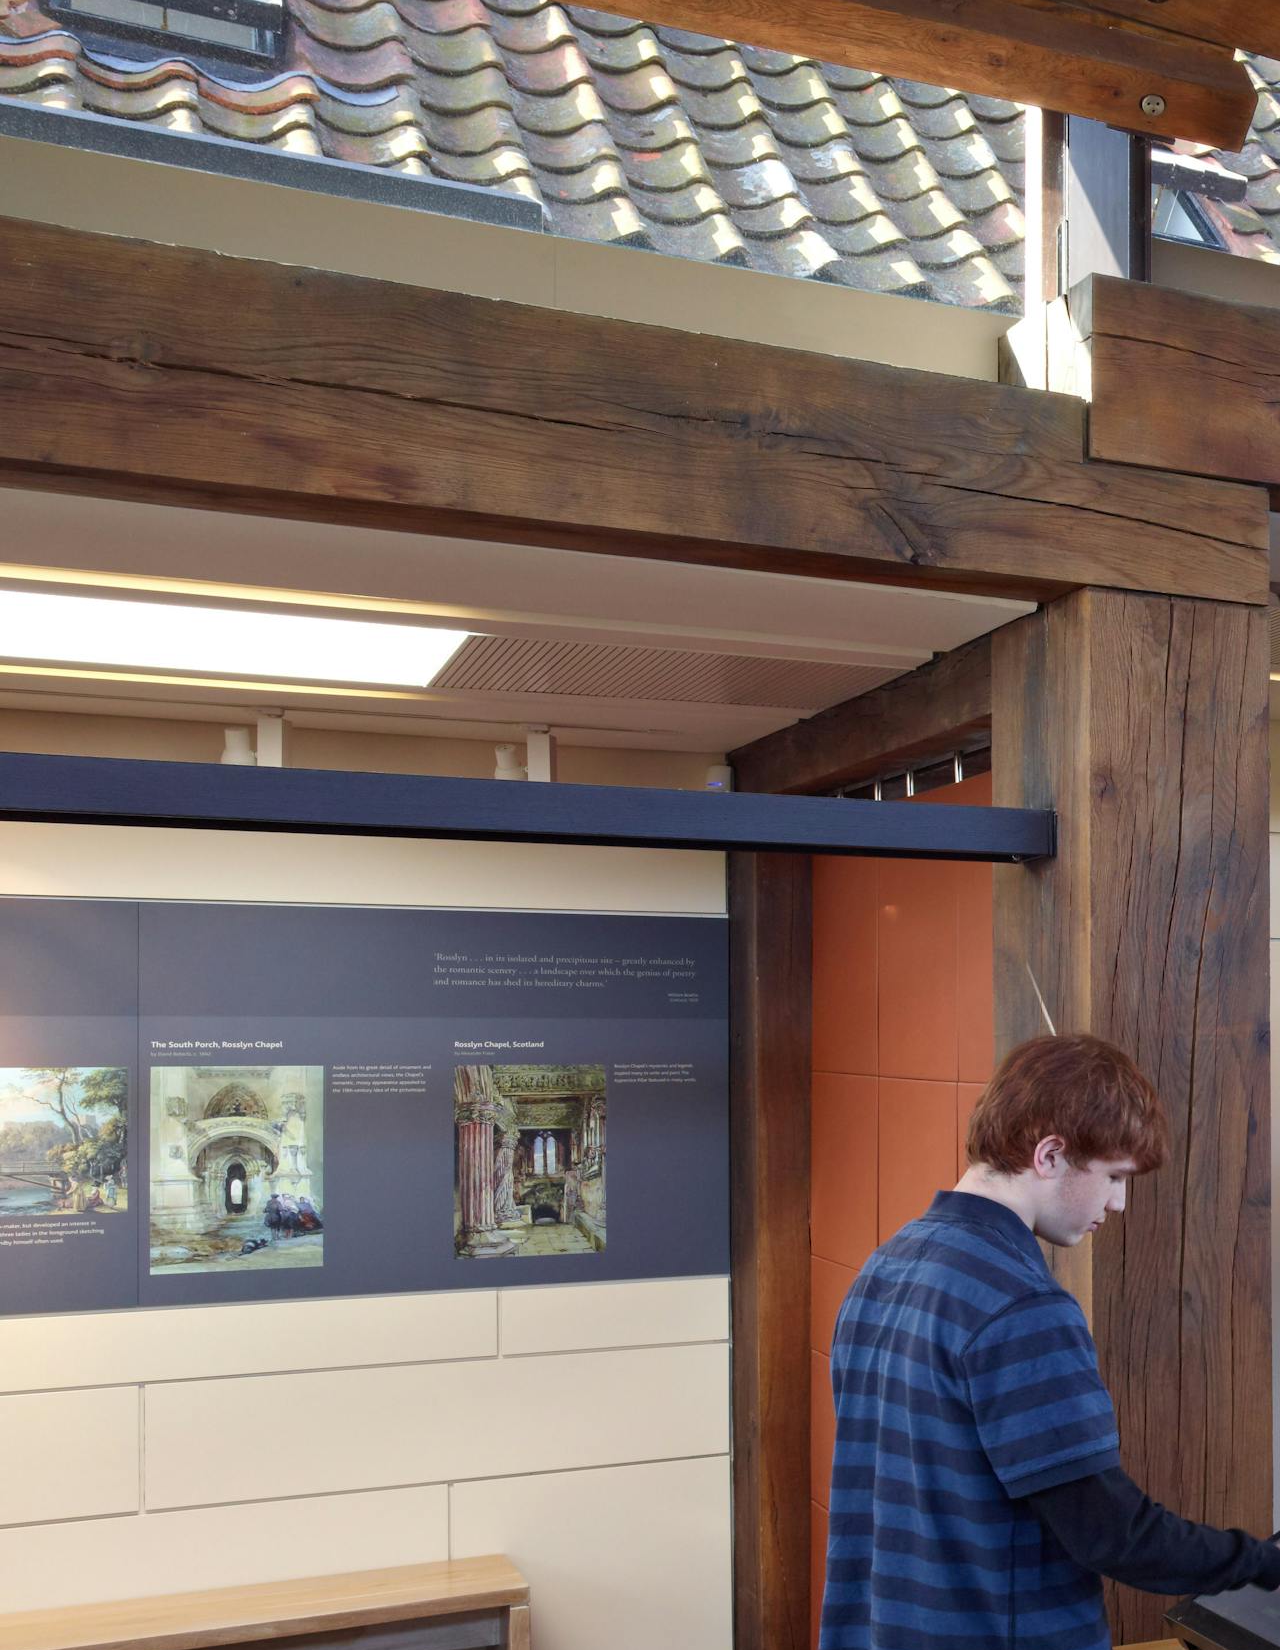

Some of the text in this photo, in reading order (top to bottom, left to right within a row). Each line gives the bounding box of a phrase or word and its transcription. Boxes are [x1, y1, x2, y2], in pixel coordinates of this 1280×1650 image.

[485, 954, 494, 962] in
[496, 954, 505, 963] its
[507, 954, 537, 963] isolated
[539, 955, 554, 963] and
[556, 955, 598, 965] precipitous
[622, 957, 647, 966] greatly
[686, 958, 696, 967] by
[434, 965, 447, 974] the
[449, 966, 485, 974] romantic
[487, 967, 516, 976] scenery
[540, 966, 577, 977] landscape
[597, 968, 621, 976] which
[623, 968, 635, 976] the
[637, 969, 661, 978] genius
[672, 970, 696, 978] poetry
[433, 977, 449, 986] and
[488, 978, 501, 986] has
[503, 978, 521, 986] shed
[523, 978, 533, 986] its
[535, 978, 574, 988] hereditary
[151, 1040, 283, 1050] The South Porch, Rosslyn Chapel
[454, 1041, 483, 1050] Rosslyn
[484, 1041, 511, 1050] Chapel,
